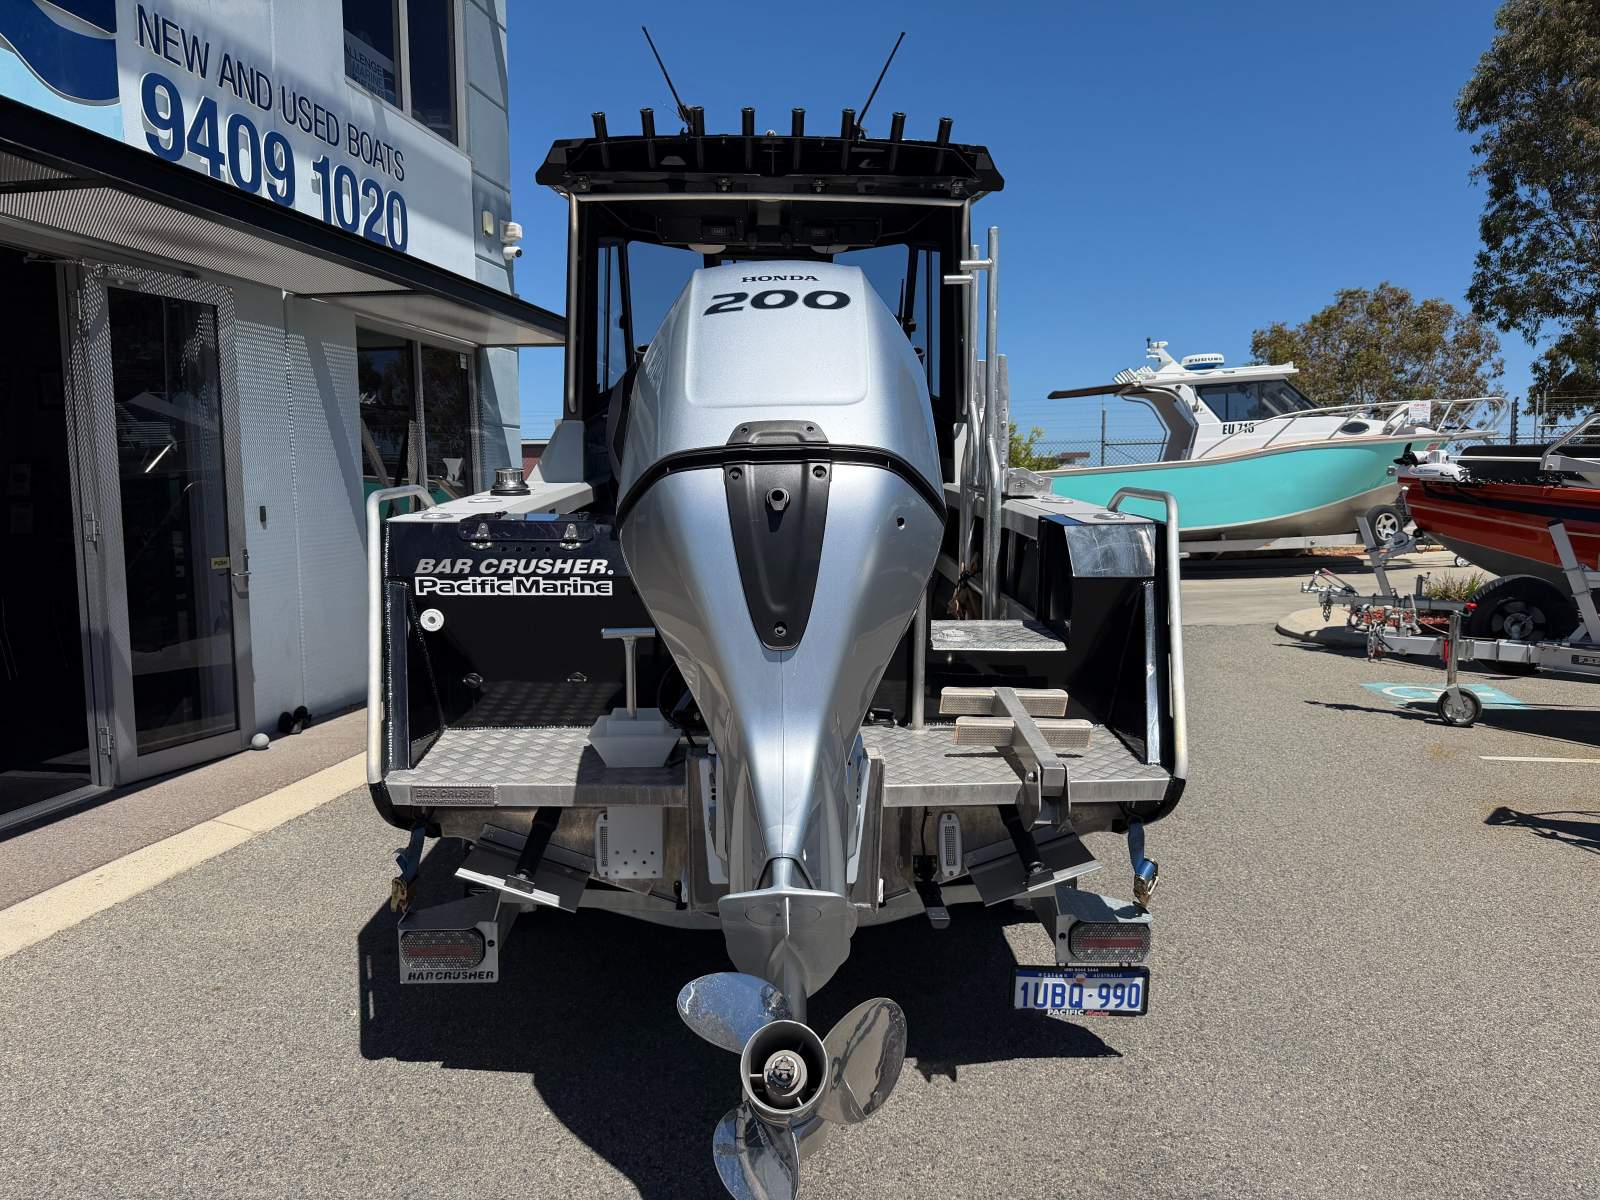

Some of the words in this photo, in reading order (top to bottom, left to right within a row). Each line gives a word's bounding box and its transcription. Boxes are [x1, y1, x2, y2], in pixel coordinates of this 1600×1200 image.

[137, 3, 210, 79] NEW
[218, 53, 273, 111] AND
[281, 85, 340, 147] USED
[348, 123, 405, 182] BOATS
[140, 72, 296, 208] 9409
[311, 154, 409, 253] 1020
[703, 290, 851, 316] 200
[1222, 424, 1235, 435] EU
[415, 558, 473, 574] BAR
[416, 789, 437, 798] BAR
[441, 789, 491, 798] CRUSHER
